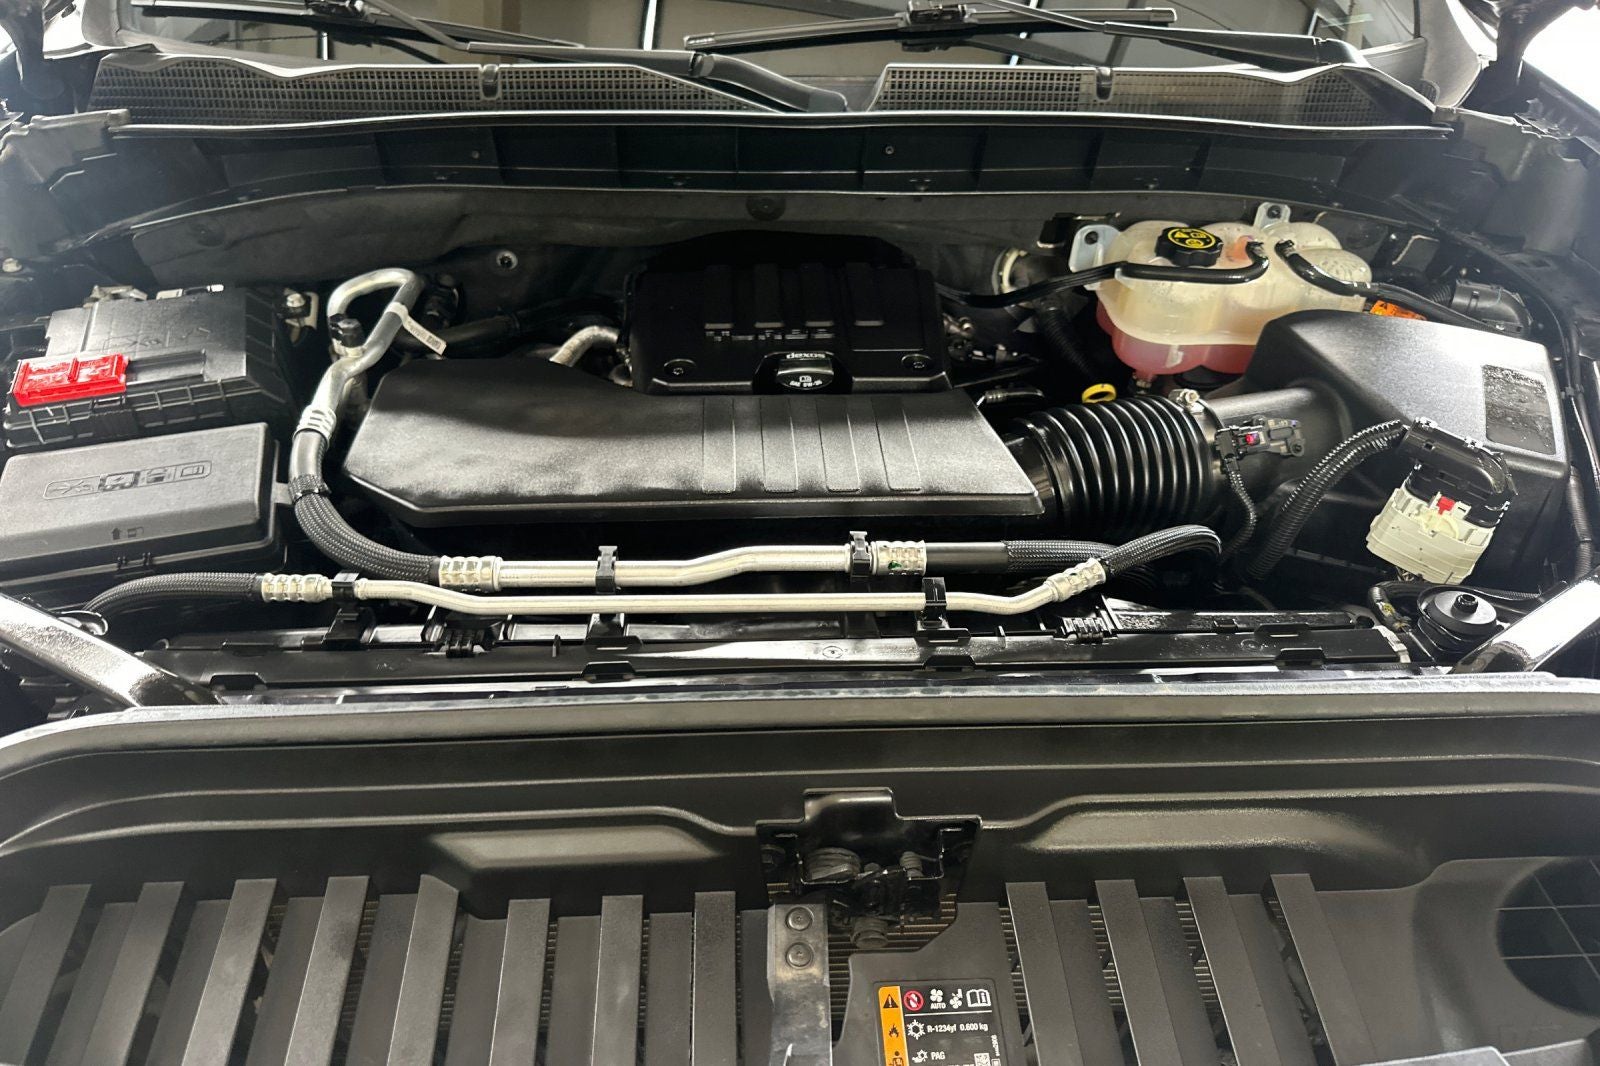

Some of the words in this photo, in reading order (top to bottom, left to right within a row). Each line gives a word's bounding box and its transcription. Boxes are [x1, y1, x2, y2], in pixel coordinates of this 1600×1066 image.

[930, 1002, 946, 1010] AUTO
[926, 1023, 957, 1033] R-1234yf
[979, 1022, 989, 1032] kg
[931, 1051, 945, 1060] PAG
